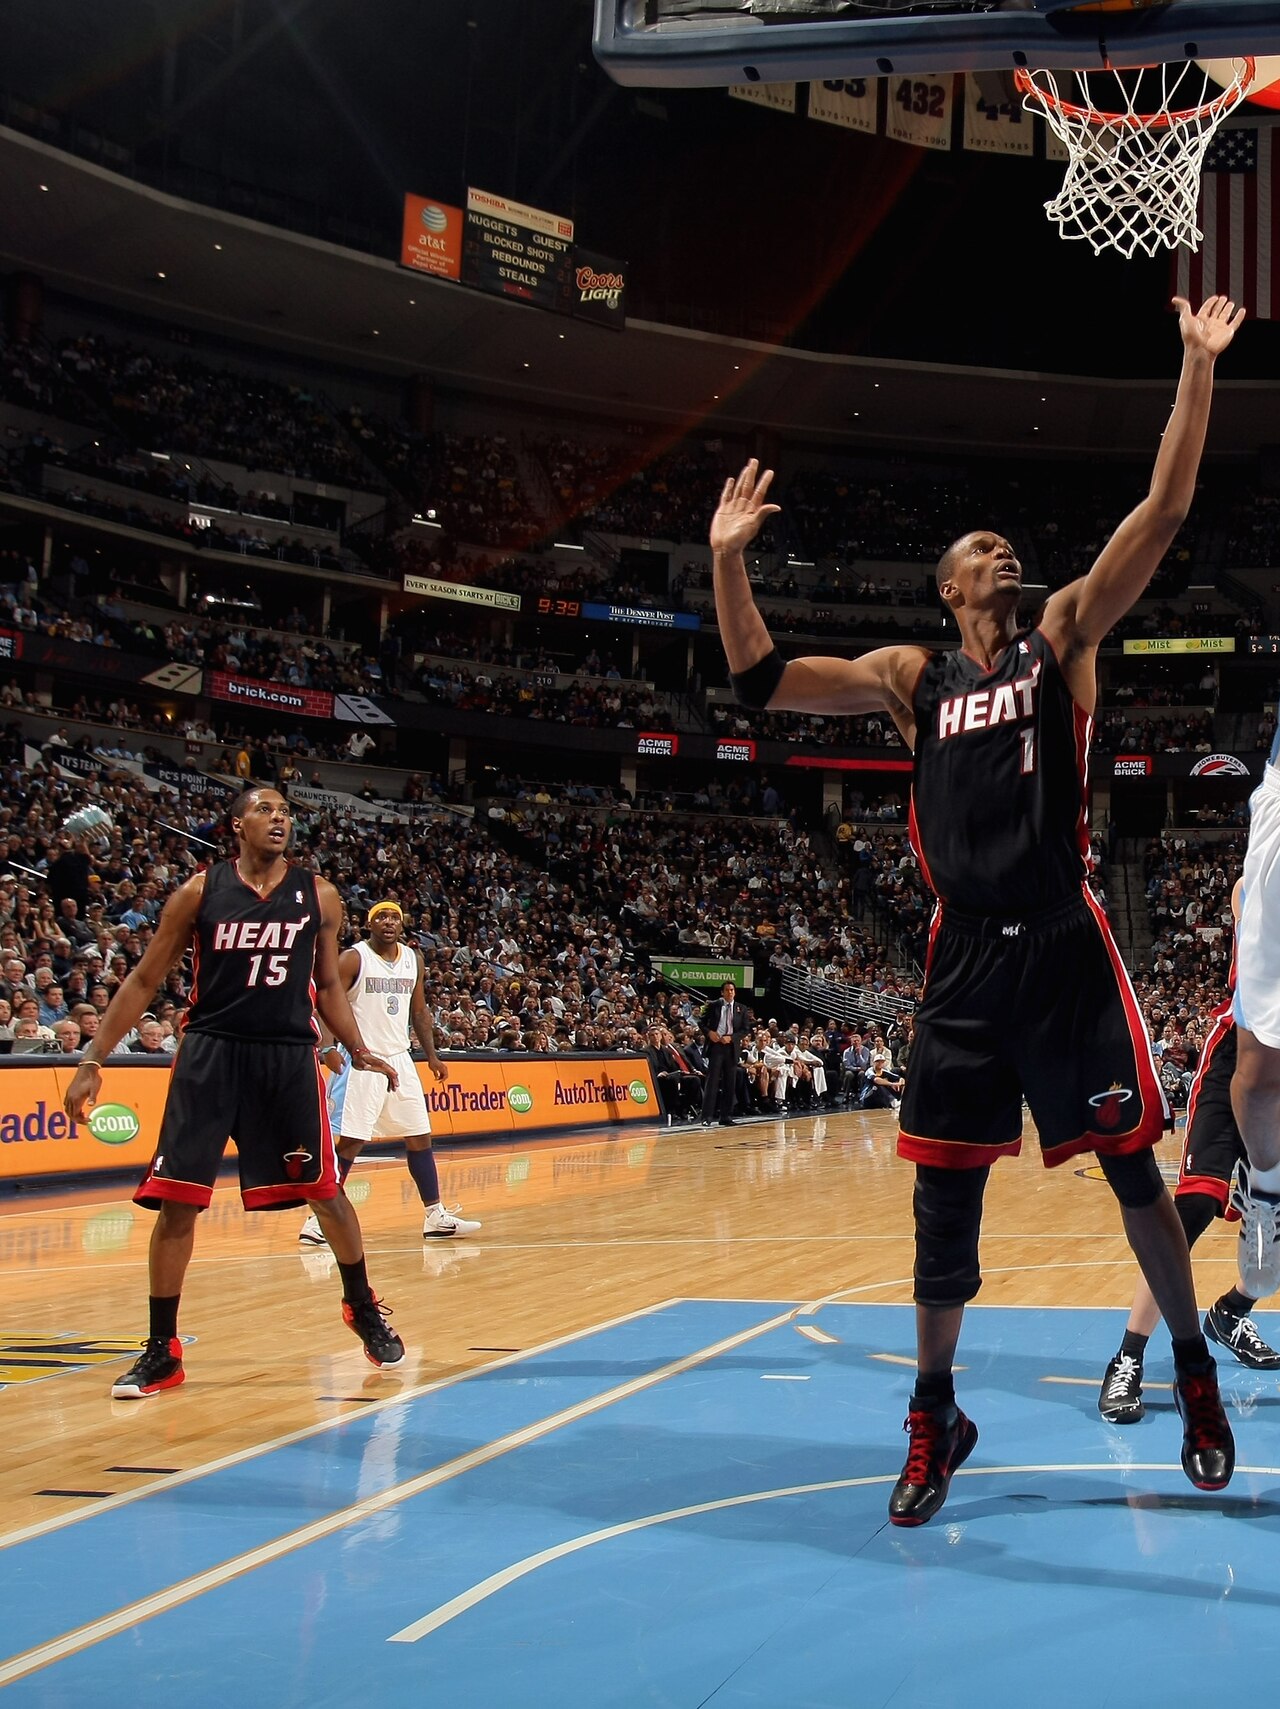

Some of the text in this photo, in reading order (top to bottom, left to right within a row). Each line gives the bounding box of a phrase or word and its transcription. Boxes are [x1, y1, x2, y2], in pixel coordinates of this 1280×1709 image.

[896, 79, 945, 118] 432
[469, 192, 506, 210] TOSHIBA
[469, 213, 518, 237] NUGGETS
[532, 234, 569, 252] GUEST
[419, 234, 445, 252] at&t
[484, 232, 524, 252] BLOCKED
[527, 246, 555, 263] SHOTS
[492, 250, 545, 274] REBOUNDS
[499, 267, 538, 287] STEALS
[576, 266, 624, 290] Coors
[580, 288, 622, 302] LIGHT
[406, 579, 428, 590] EVERY
[429, 583, 458, 596] SEASON
[458, 589, 484, 601] STARTS
[484, 593, 494, 602] AT
[538, 598, 579, 617] 9:39
[1147, 639, 1171, 649] Mist
[1200, 638, 1224, 648] Mist
[536, 676, 552, 685] 210
[228, 681, 303, 707] brick.com
[939, 660, 1041, 740] HEAT
[637, 747, 671, 756] BRICK
[638, 738, 672, 748] ACME
[717, 744, 750, 754] ACME
[1020, 727, 1035, 773] 1
[60, 754, 78, 769] TY'S
[716, 752, 750, 762] BRICK
[1114, 761, 1146, 769] ACME
[159, 769, 208, 785] PC'S POINT
[1114, 768, 1146, 776] BRICK
[293, 790, 338, 803] CHAUNCEY'S
[214, 914, 311, 950] HEAT
[247, 954, 289, 987] 15
[681, 971, 736, 981] DELTA DENTAL
[386, 995, 399, 1016] 3
[554, 1079, 628, 1106] AutoTrader
[91, 1113, 135, 1133] .com
